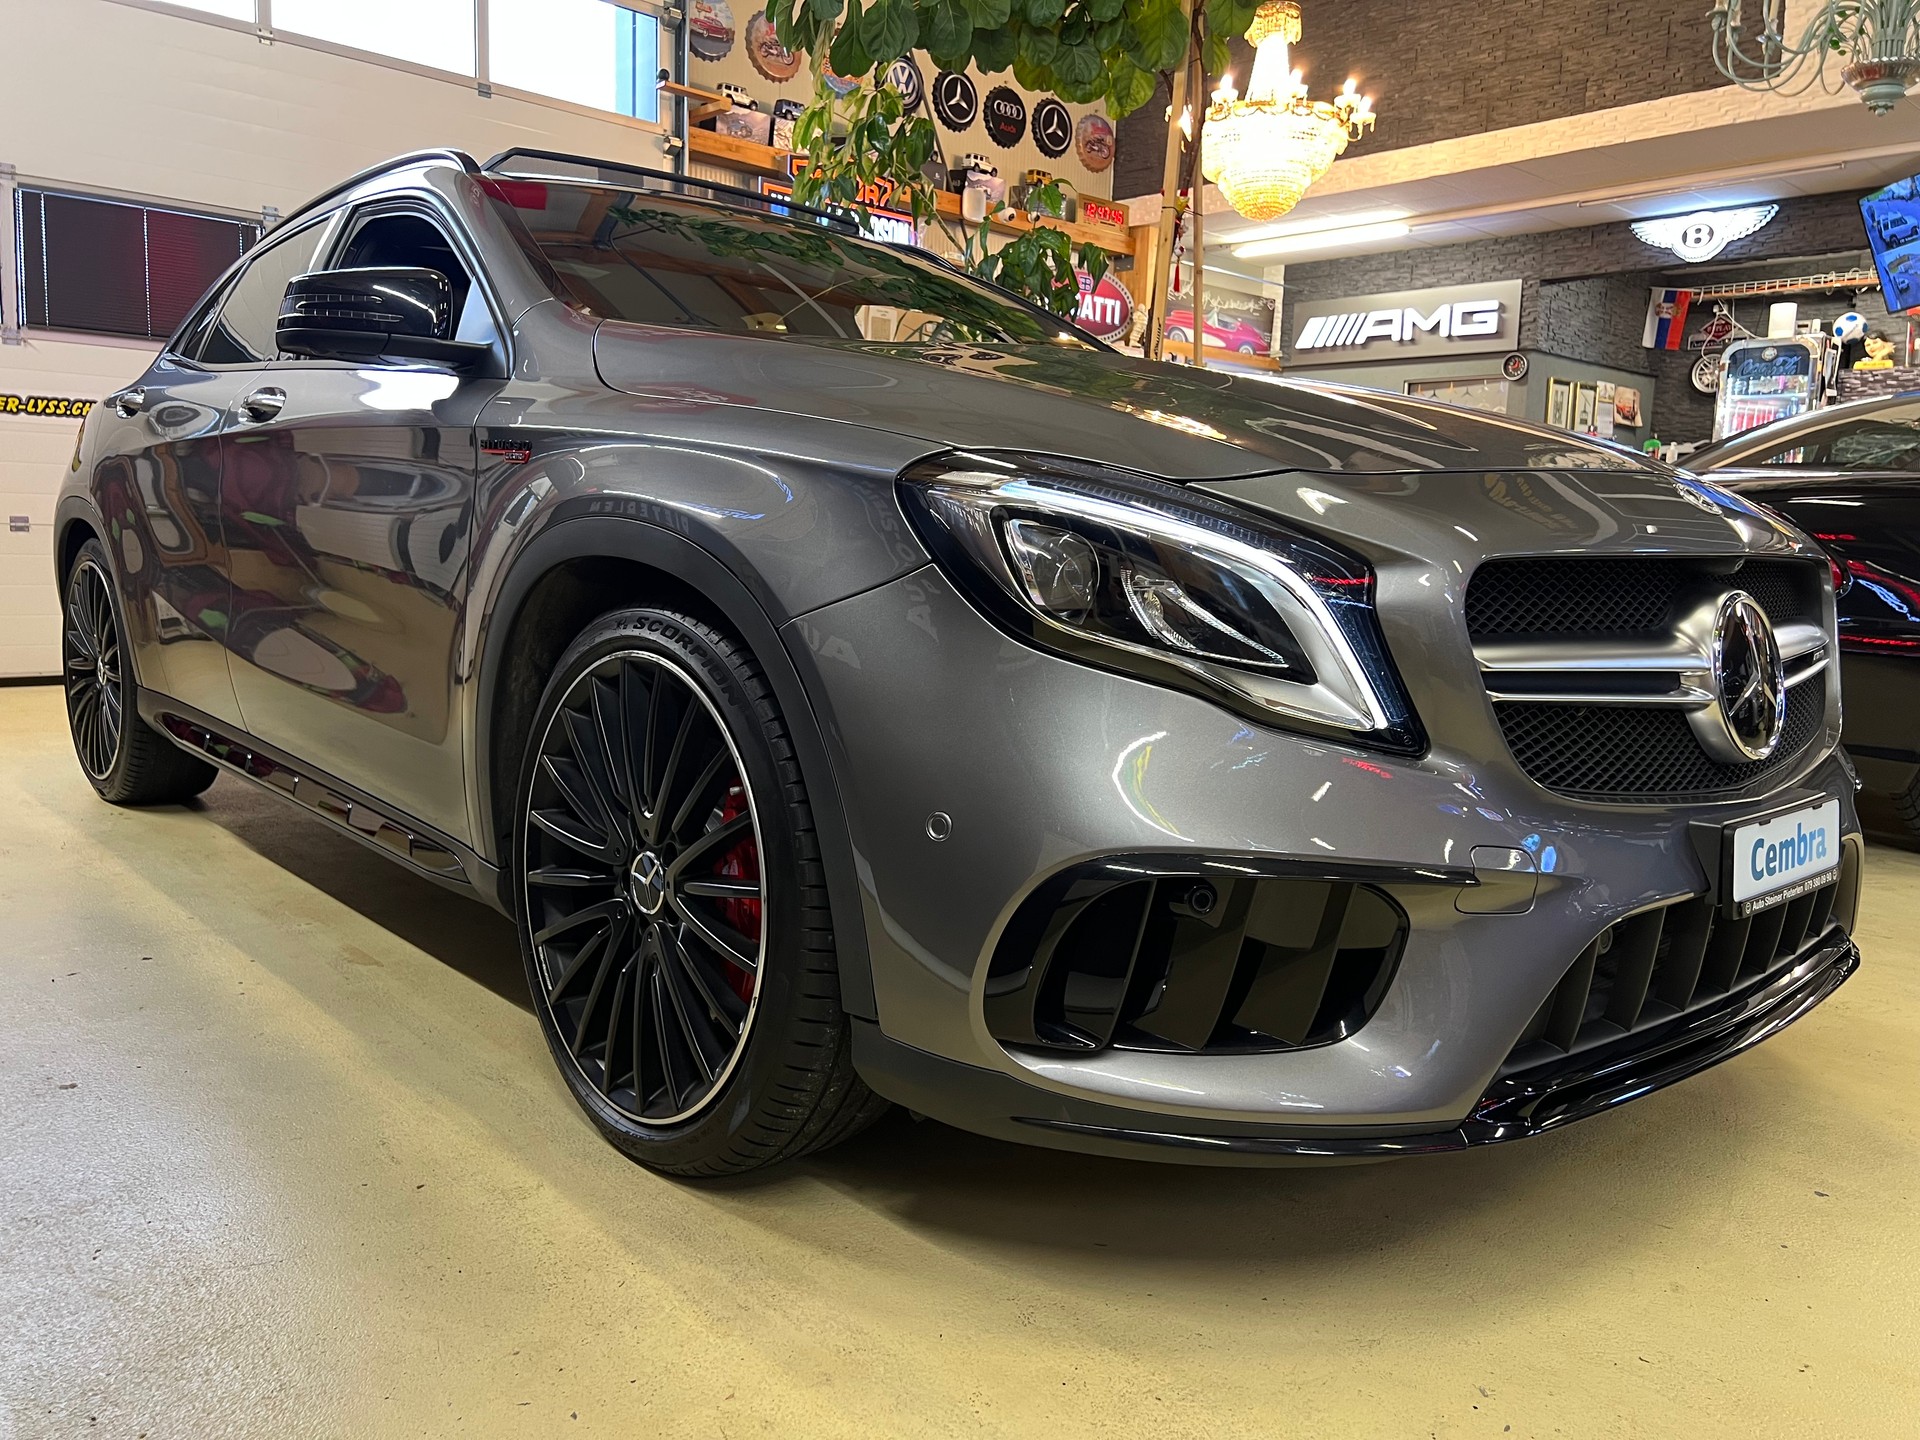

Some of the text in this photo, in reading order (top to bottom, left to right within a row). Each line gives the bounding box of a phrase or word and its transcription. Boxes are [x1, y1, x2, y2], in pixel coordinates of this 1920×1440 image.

[999, 121, 1017, 134] Audi
[1043, 293, 1121, 327] ATTI
[1354, 299, 1499, 345] AMG
[632, 616, 739, 707] SCORPION
[1751, 822, 1827, 882] Cembra
[1752, 899, 1765, 911] Auto
[1765, 892, 1783, 906] Steiner
